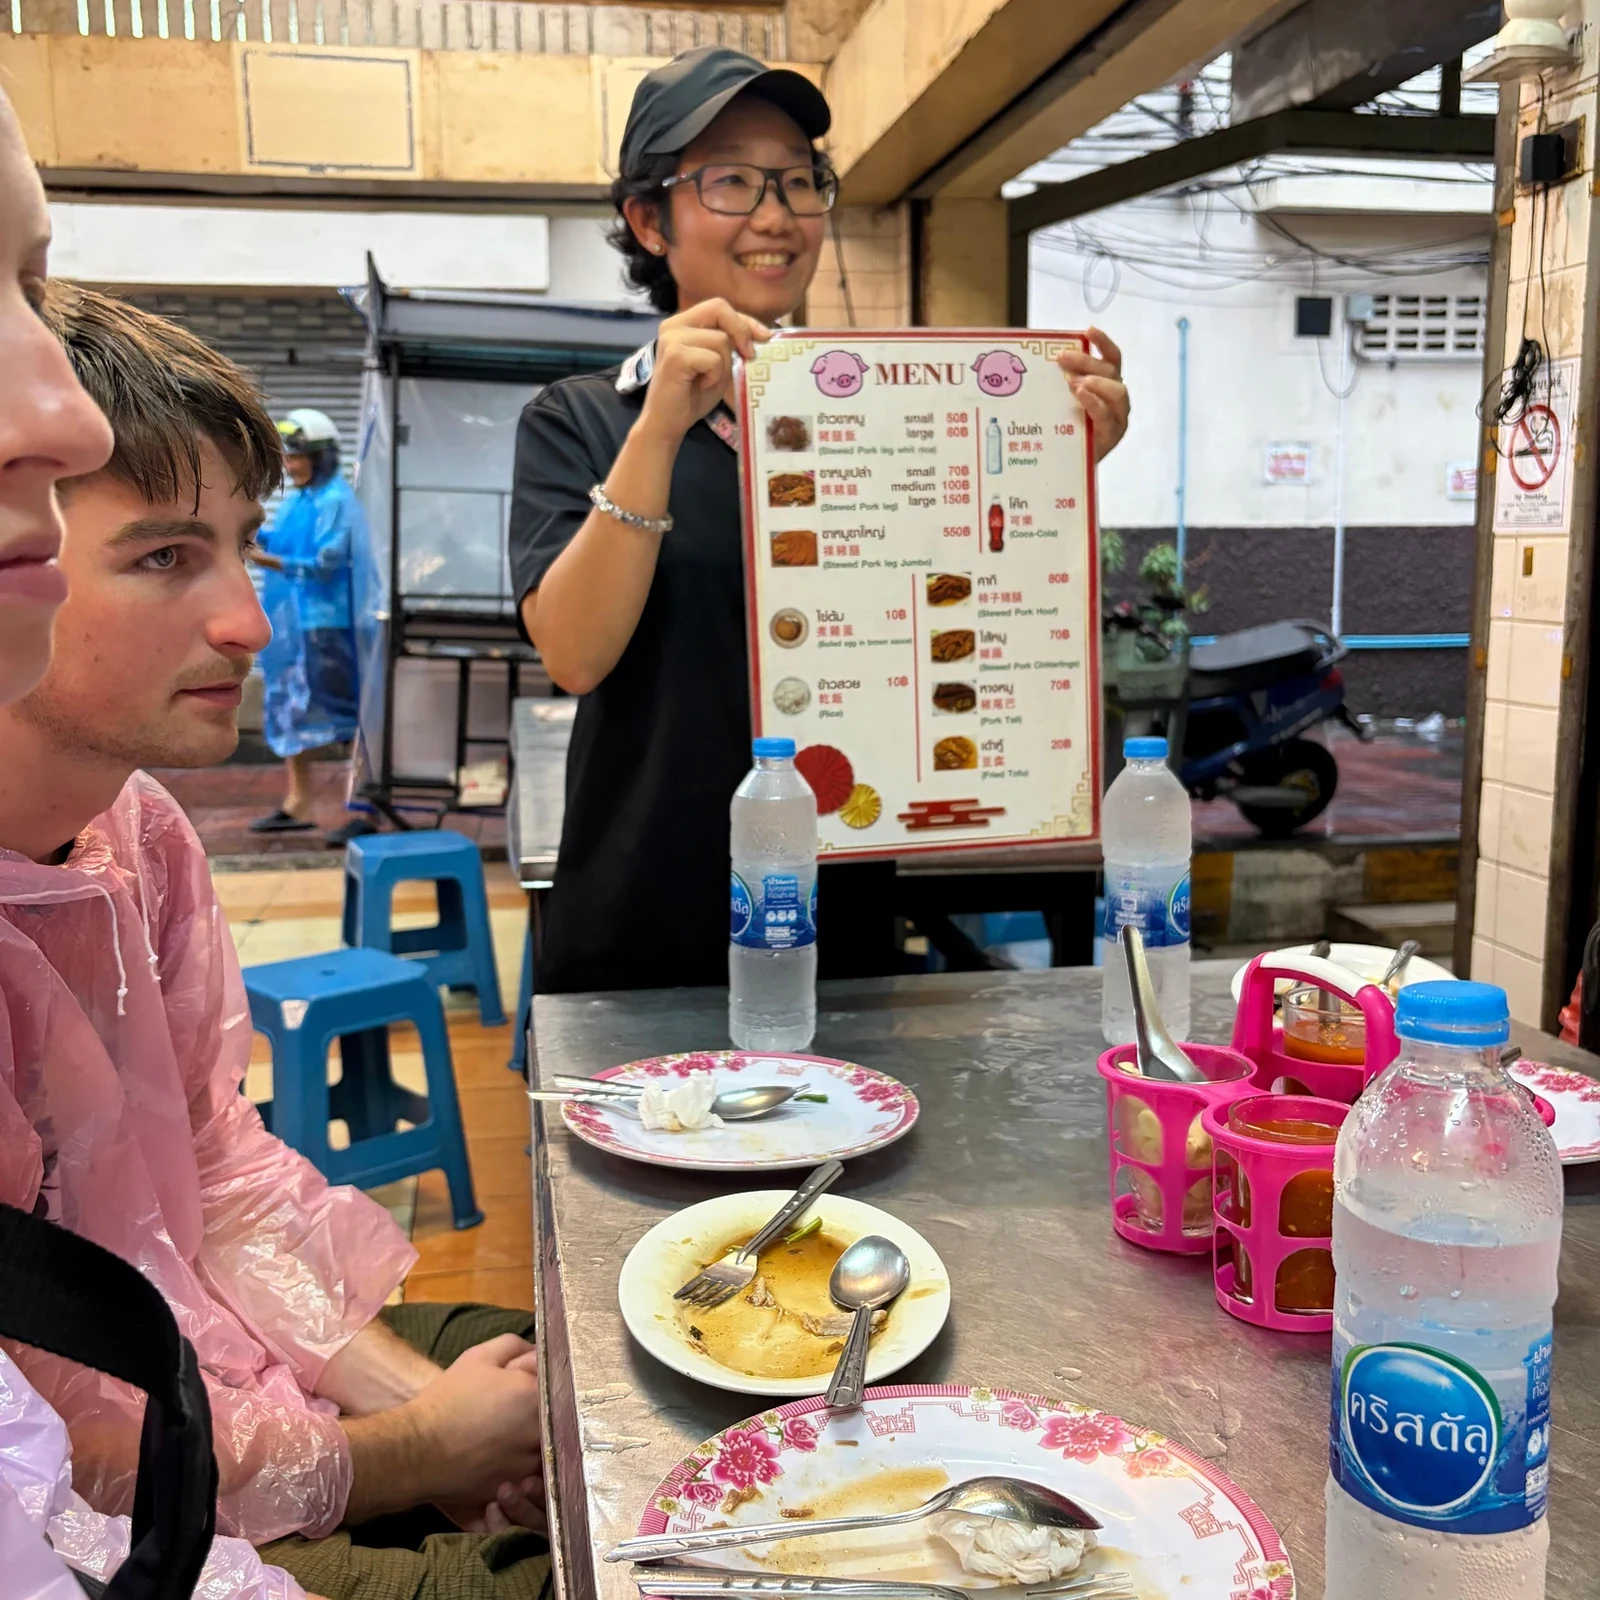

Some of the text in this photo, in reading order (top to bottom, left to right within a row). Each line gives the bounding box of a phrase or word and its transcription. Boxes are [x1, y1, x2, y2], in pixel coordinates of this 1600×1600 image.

[874, 363, 965, 385] MENU
[904, 412, 933, 424] small
[906, 428, 934, 440] large
[857, 446, 877, 455] Pork
[1008, 457, 1037, 467] (Water)
[906, 466, 935, 477] small
[891, 481, 936, 492] medium
[908, 495, 936, 507] large
[821, 502, 898, 513] (Stewed Pork leg)
[1009, 529, 1058, 539] (Coca-Cola)
[823, 559, 932, 571] (Stewed Pork leg Jumbo)
[978, 607, 1058, 619] (Stewed Pork Hoof)
[844, 640, 857, 648] egg
[1014, 662, 1031, 670] Pork
[819, 710, 844, 719] (Rice)
[980, 716, 1022, 726] (Pork Tail)
[981, 770, 1029, 780] (Fried Tofu)
[1351, 1391, 1488, 1455] คริสตัล
